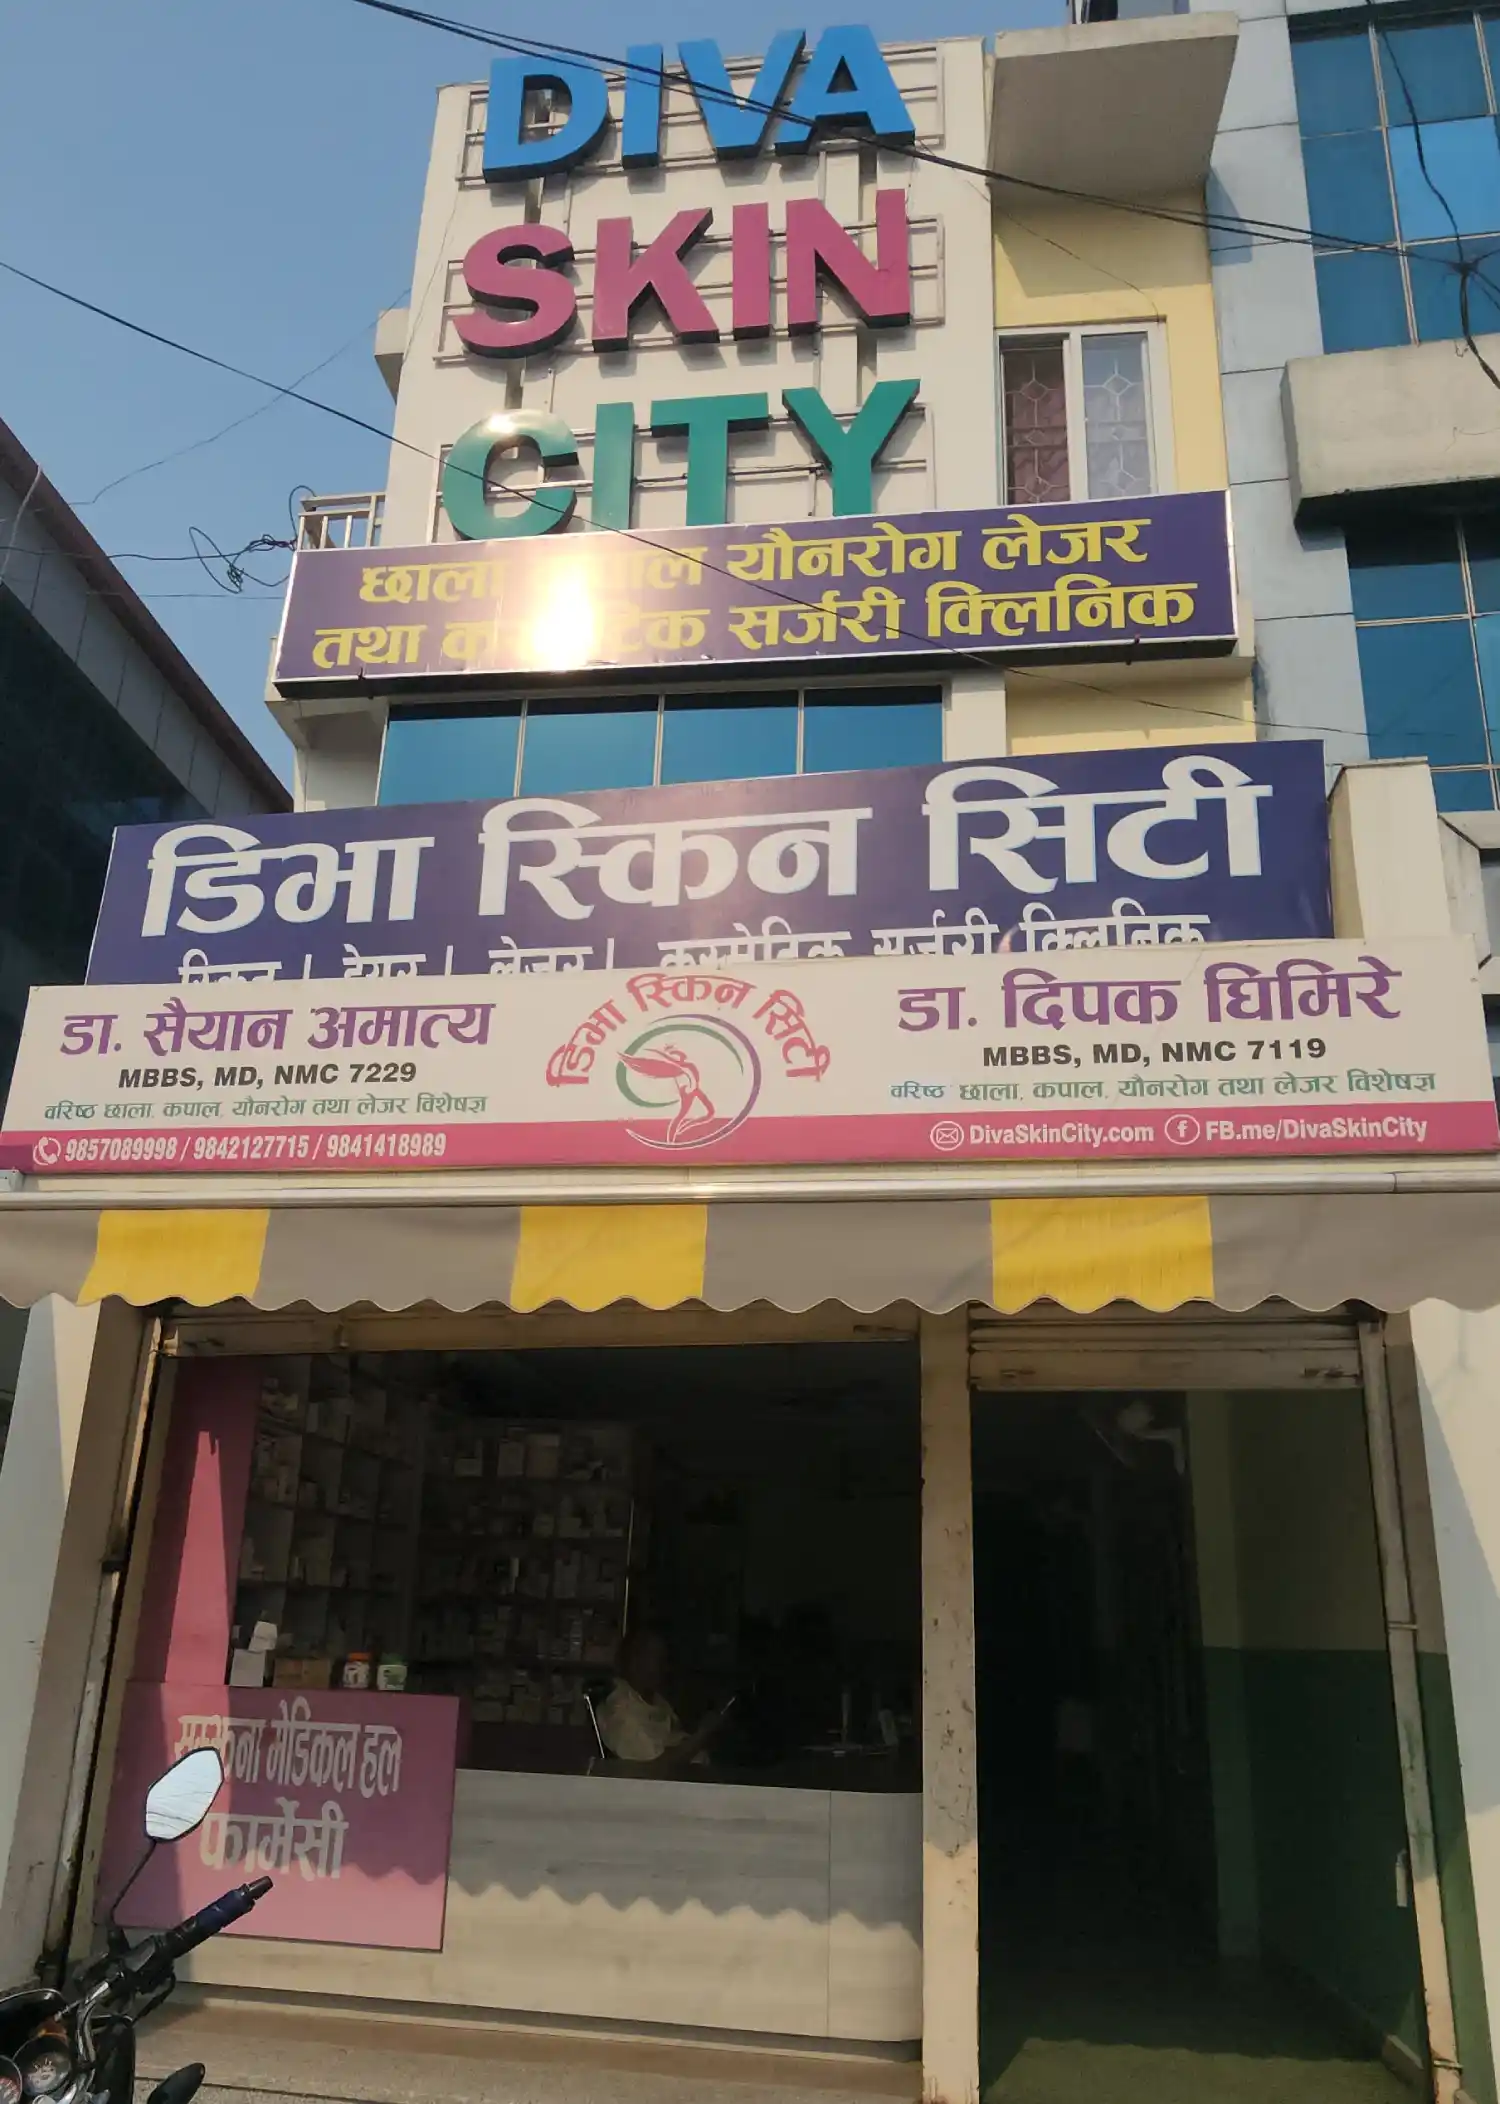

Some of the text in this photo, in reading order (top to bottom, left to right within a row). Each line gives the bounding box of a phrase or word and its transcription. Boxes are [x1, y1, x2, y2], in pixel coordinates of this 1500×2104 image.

[483, 24, 915, 182] DIVA
[453, 189, 910, 359] SKIN
[443, 379, 920, 541] CITY
[727, 521, 962, 581] यौनरोग
[981, 514, 1152, 570] लेजर
[312, 624, 427, 669] तथा
[728, 589, 905, 650] सर्जरी
[926, 573, 1198, 638] क्लिनिक
[141, 755, 1273, 937] डिभा स्किन सिटी
[898, 956, 1402, 1031] डा. दिपक घिमिरे
[59, 997, 497, 1056] डा. सैयान अमात्य
[546, 973, 831, 1088] डिभा स्किन सिटी
[983, 1038, 1326, 1068] MBBS, MD, NMC 7119
[44, 1100, 97, 1119] वरिष्ठ
[232, 1095, 306, 1117] यौनरोग
[312, 1097, 352, 1115] तथा
[357, 1093, 410, 1115] लेजर
[416, 1092, 488, 1113] विशेषज्ञ
[118, 1062, 417, 1089] MBBS, MD, NMC 7229
[890, 1081, 946, 1099] वरिष्ठ
[1118, 1074, 1209, 1097] यौनरोग
[1218, 1077, 1266, 1096] तथा
[1274, 1071, 1339, 1095] लेजर
[1346, 1068, 1436, 1092] विशेषज्ञ
[65, 1137, 177, 1162] 9857089998
[193, 1135, 309, 1159] 9842127715
[327, 1133, 447, 1157] 9841418989
[970, 1120, 1155, 1147] DivaSkinCity.com
[1206, 1116, 1428, 1142] FB.me/DivaSkinCity
